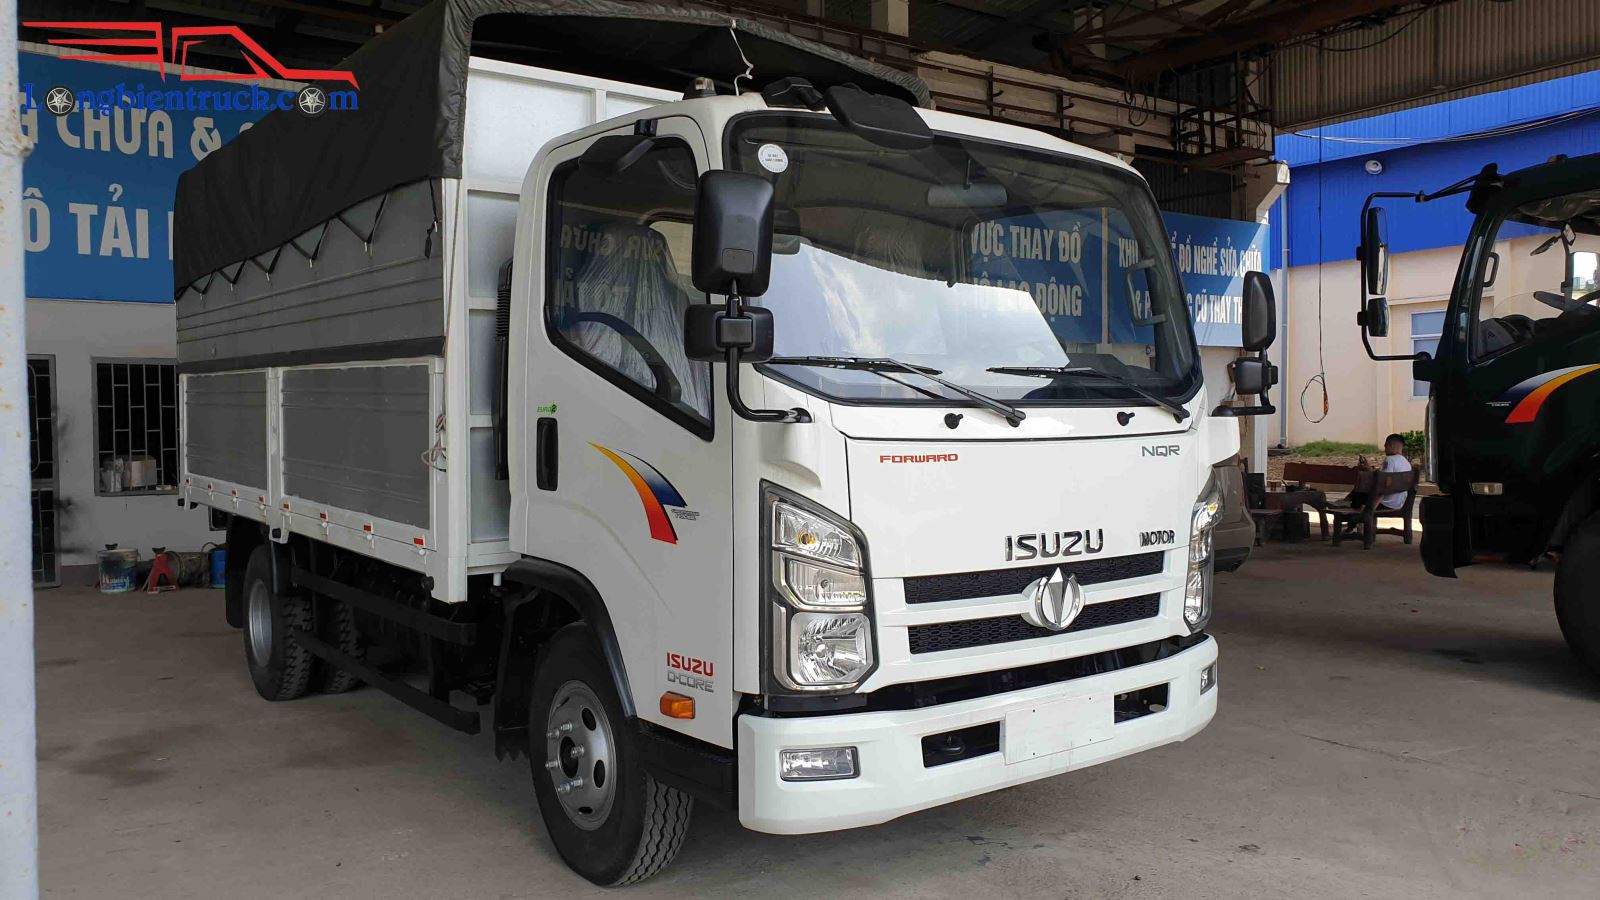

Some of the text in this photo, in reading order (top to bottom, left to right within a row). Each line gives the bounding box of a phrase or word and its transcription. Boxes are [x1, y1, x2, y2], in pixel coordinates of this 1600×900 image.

[68, 183, 150, 259] TẢI
[970, 220, 1005, 262] VỰC
[1009, 225, 1054, 261] THAY
[1035, 276, 1082, 322] ĐỘNG
[1209, 294, 1232, 324] THAY
[880, 453, 959, 464] FORWARD
[1141, 445, 1181, 457] NQR
[1005, 528, 1104, 561] ISUZU
[1139, 529, 1175, 546] MOTOR
[666, 652, 714, 677] ISUZU
[667, 670, 714, 693] D-CORE
